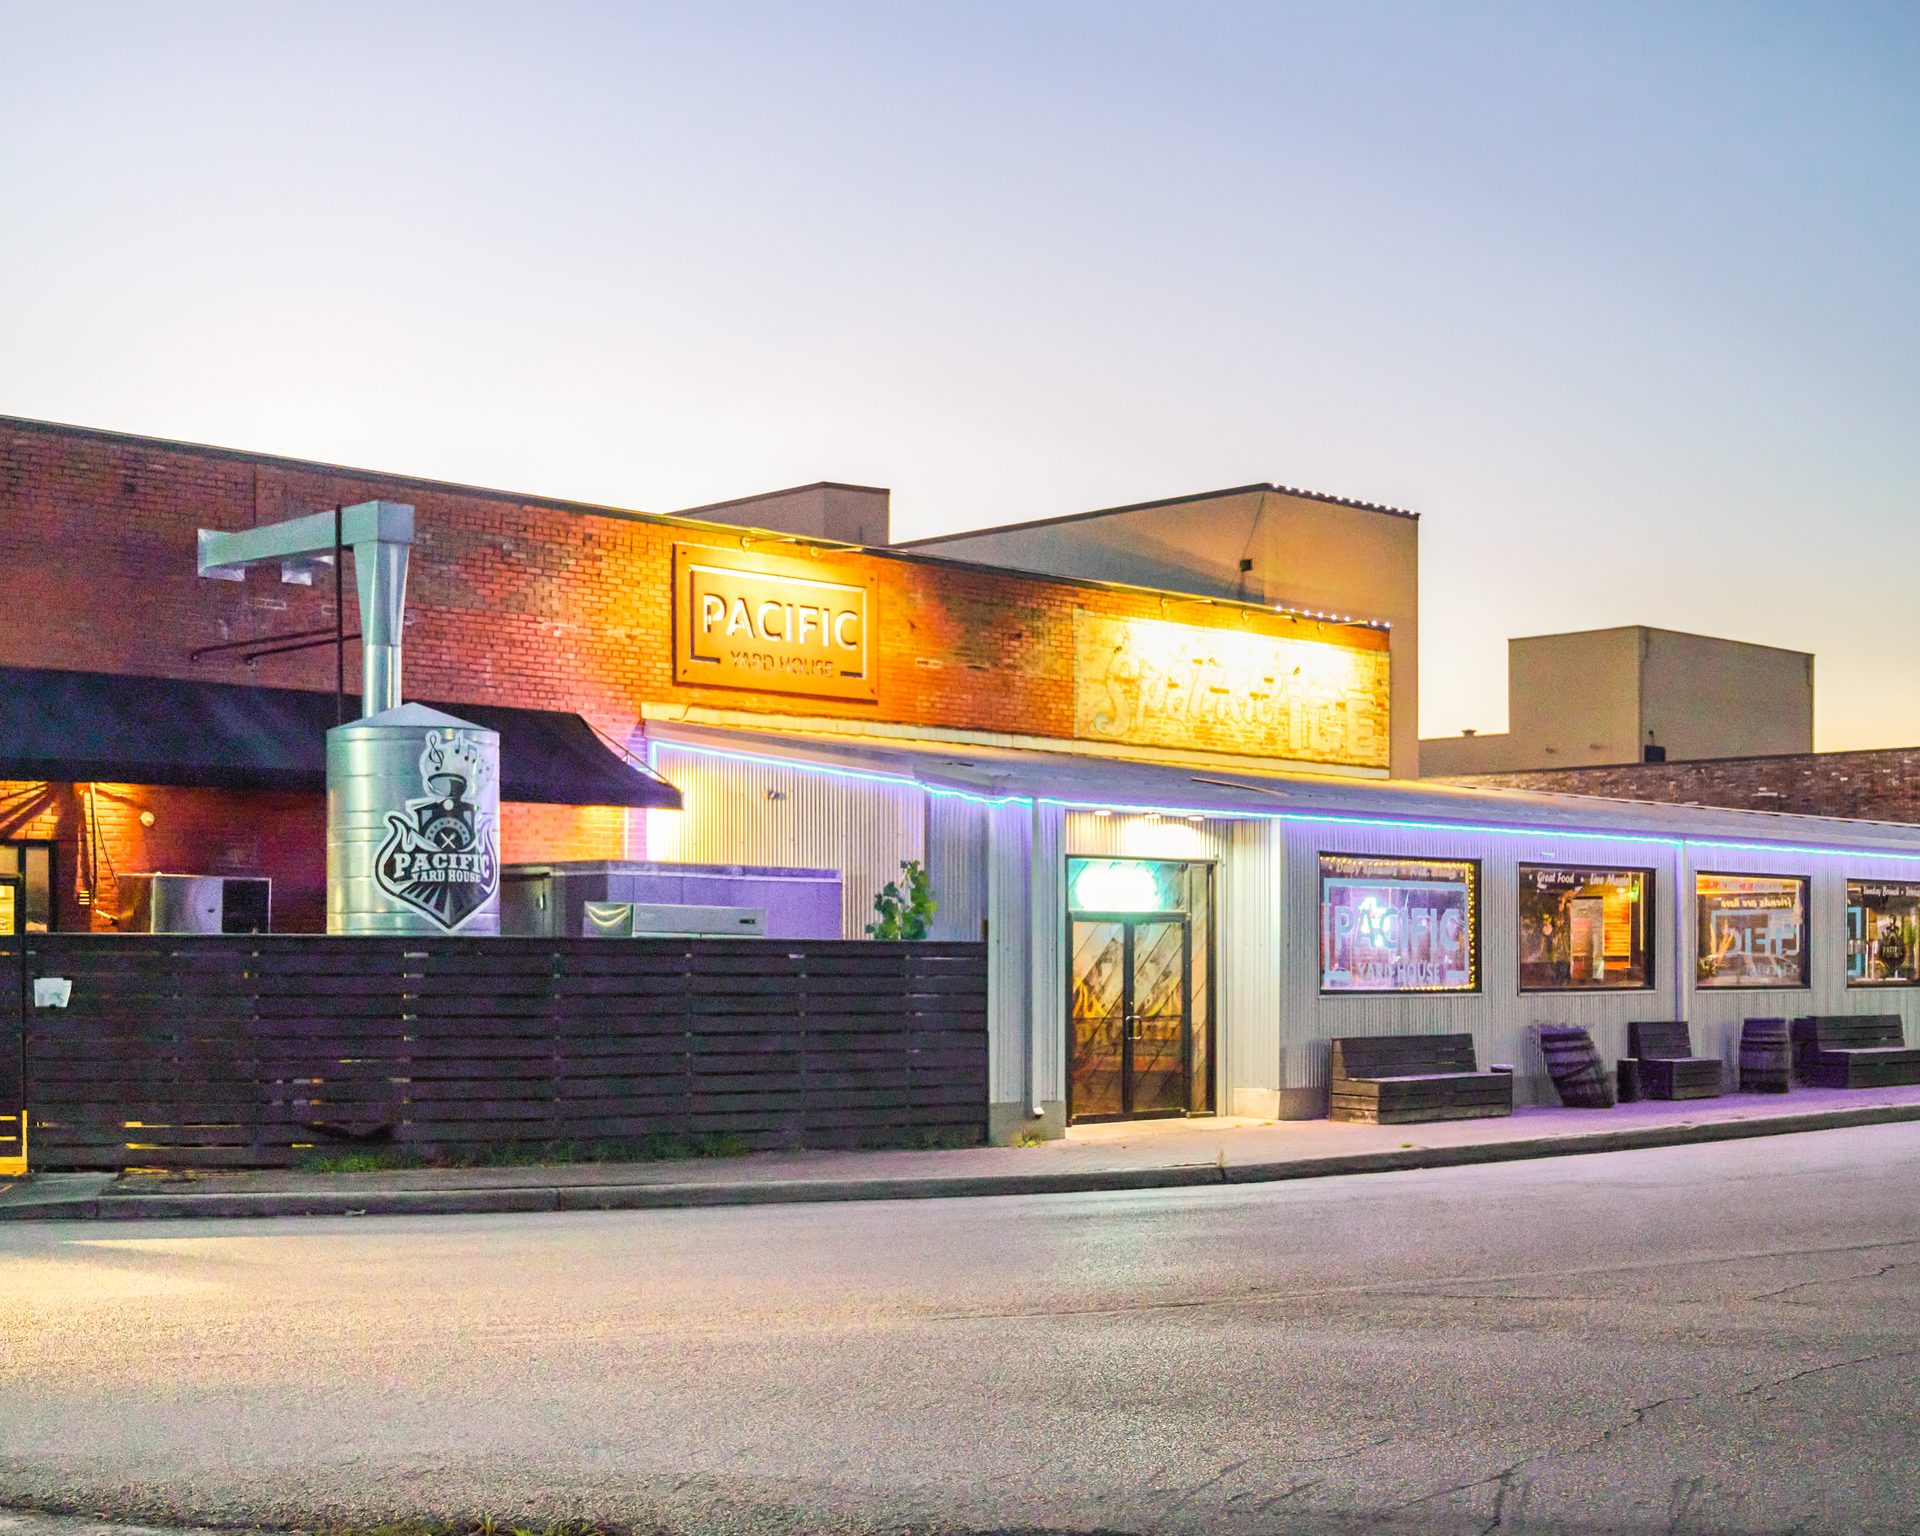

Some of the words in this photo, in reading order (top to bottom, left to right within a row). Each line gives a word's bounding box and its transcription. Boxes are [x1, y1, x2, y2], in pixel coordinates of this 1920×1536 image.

[702, 593, 858, 651] PACIFIC
[730, 650, 775, 672] YARD
[779, 655, 834, 678] HOUSE
[393, 852, 490, 879] PACIFIC
[412, 870, 445, 882] YARD
[447, 870, 481, 883] HOUSE
[1536, 871, 1556, 885] Great
[1557, 872, 1575, 884] Food
[1333, 904, 1463, 951] PACIFIC
[1359, 962, 1393, 979] YARD
[1397, 962, 1441, 984] HOUSE
